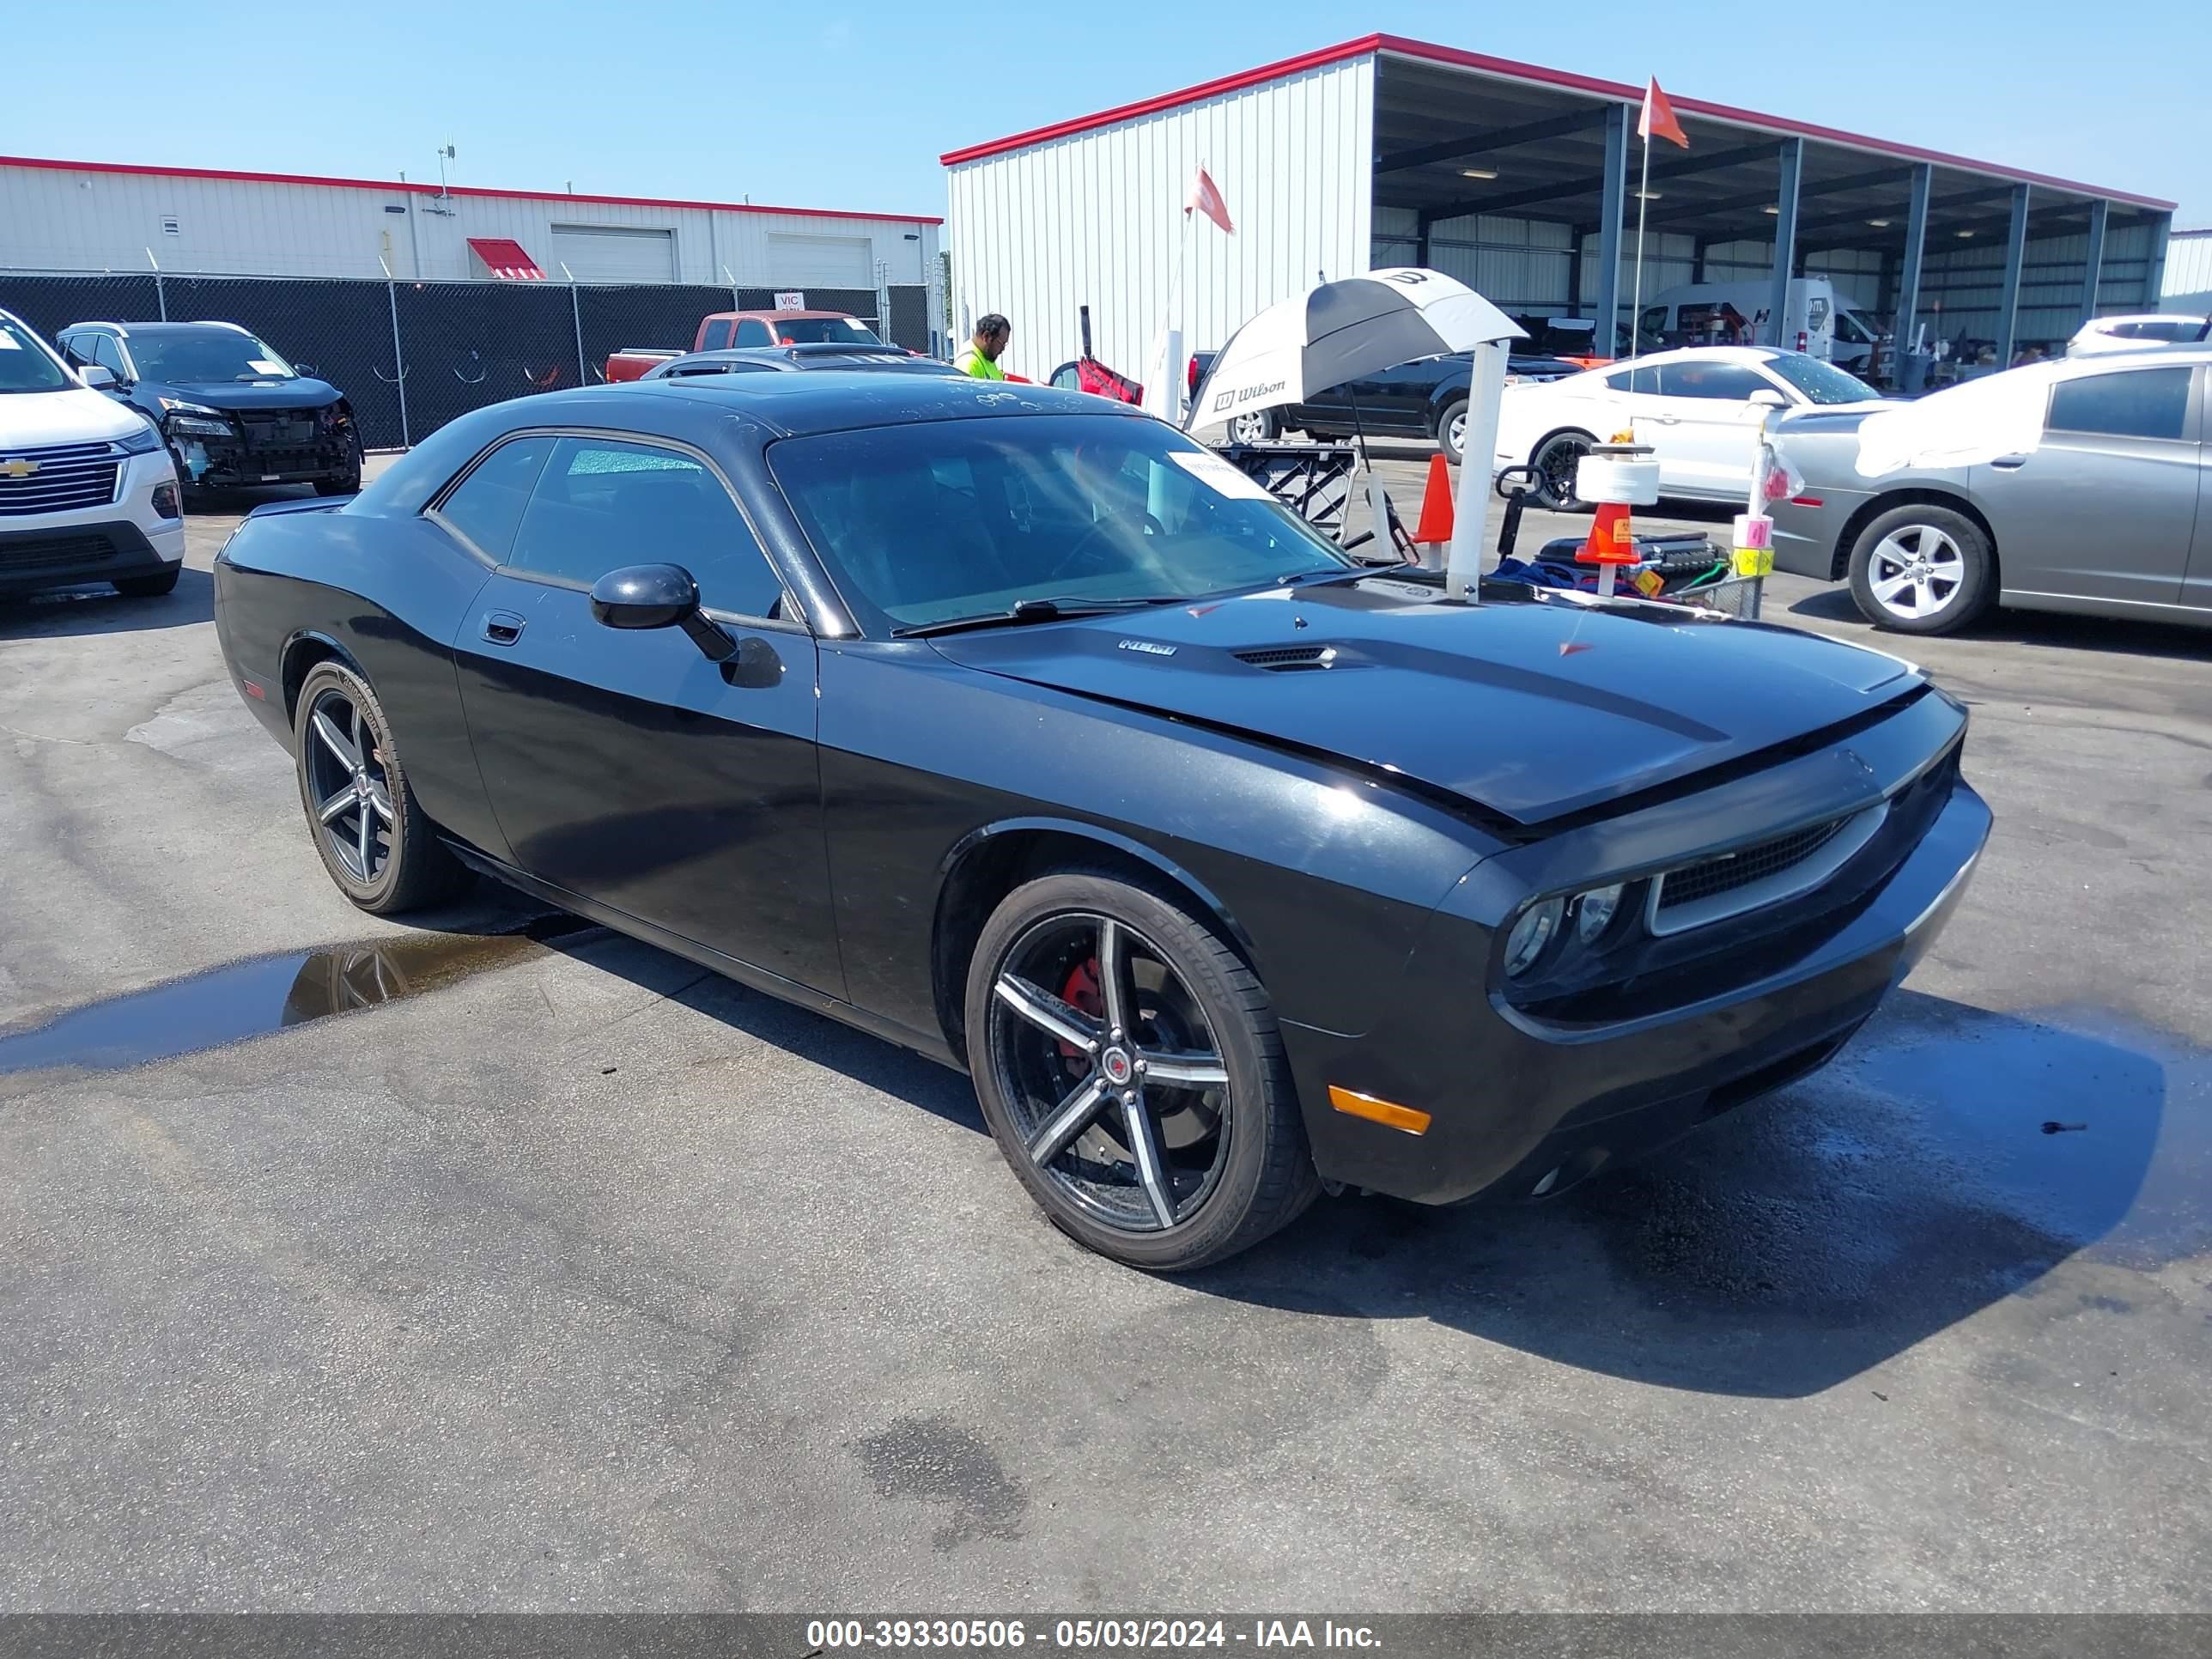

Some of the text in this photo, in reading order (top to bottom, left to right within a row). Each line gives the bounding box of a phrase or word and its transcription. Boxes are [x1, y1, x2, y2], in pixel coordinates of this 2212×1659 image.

[781, 295, 799, 305] VIC
[1238, 380, 1285, 403] Wilson
[1118, 640, 1177, 656] HEMI
[1150, 912, 1231, 1012] SENTURY
